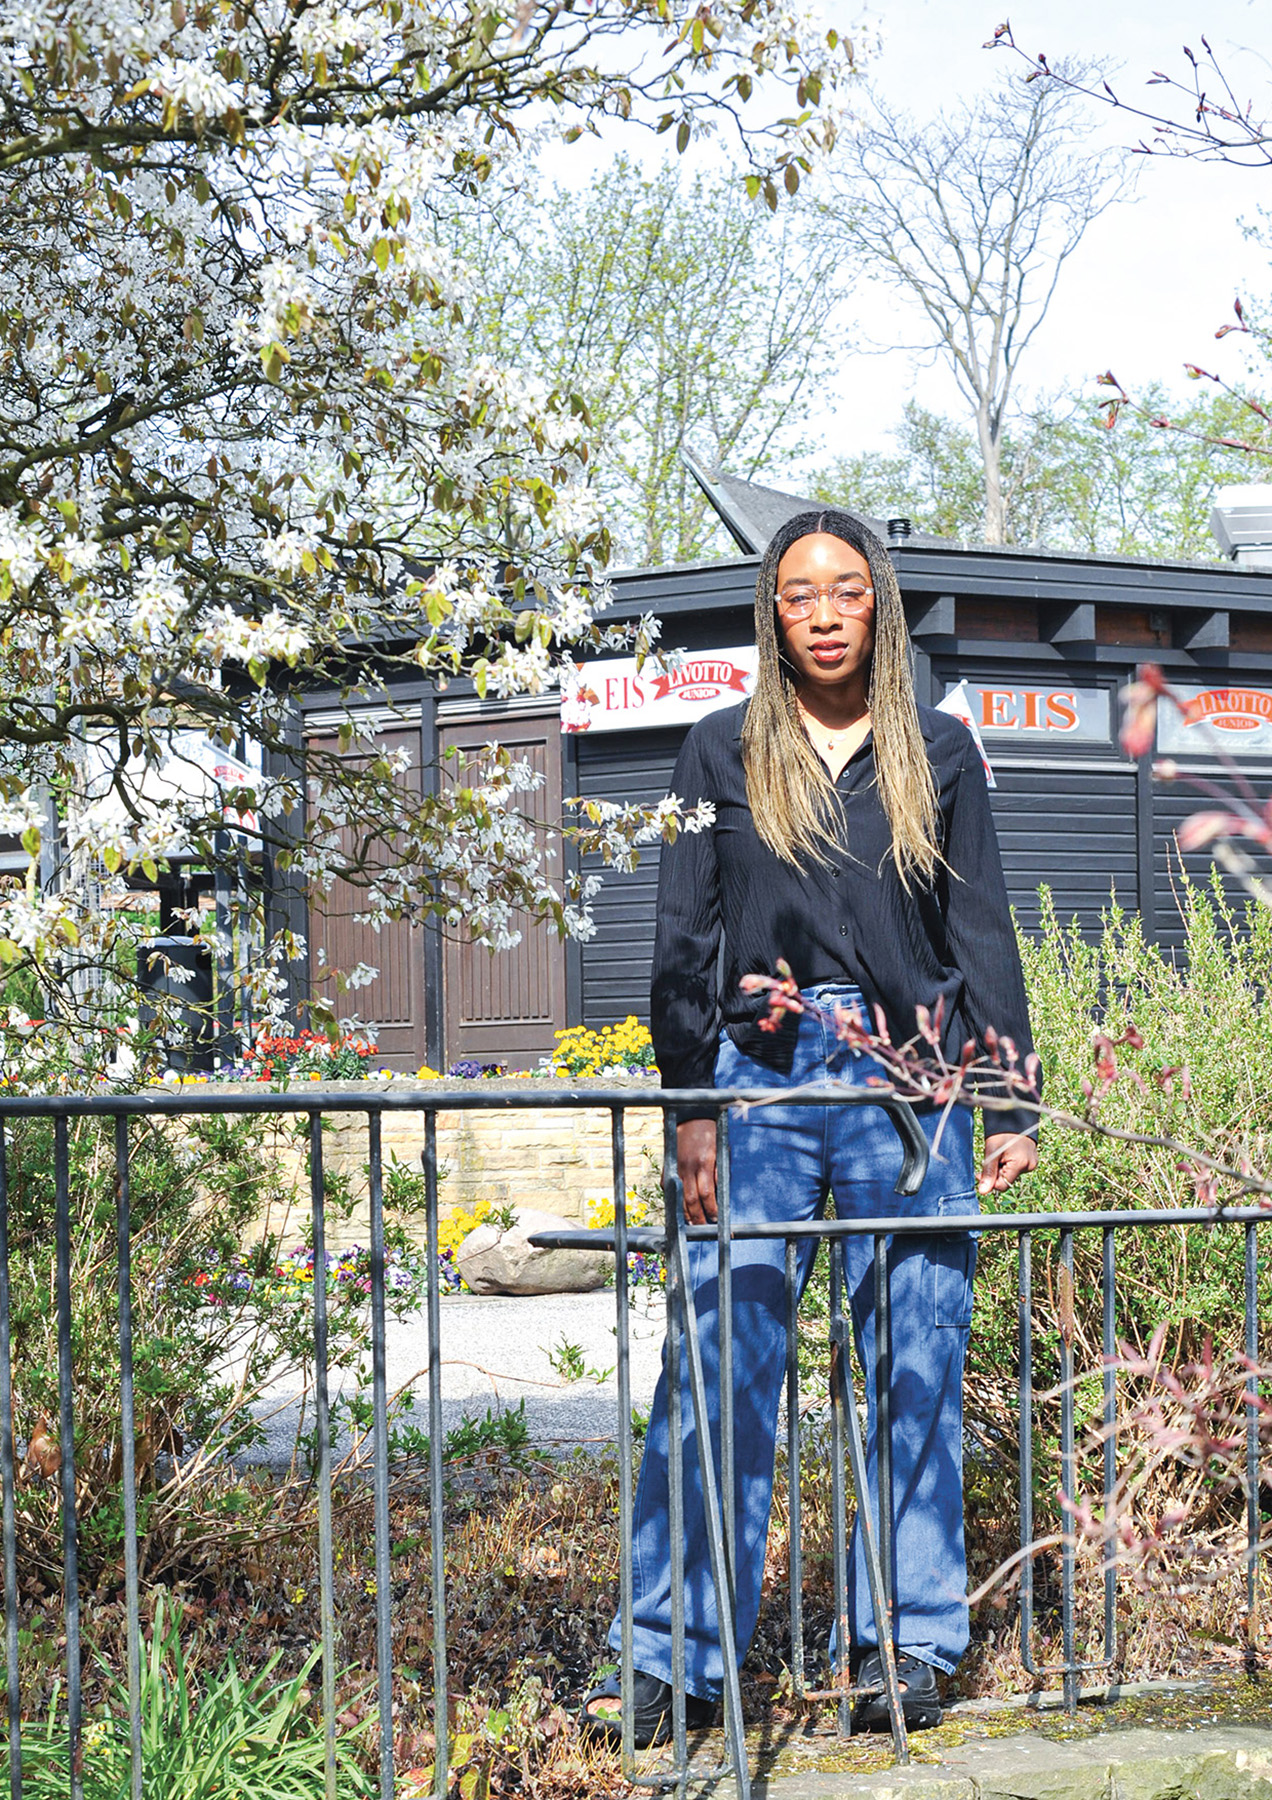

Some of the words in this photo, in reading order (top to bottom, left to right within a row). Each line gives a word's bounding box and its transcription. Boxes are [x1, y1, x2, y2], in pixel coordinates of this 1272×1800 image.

[668, 662, 732, 687] LIVOTTO
[605, 675, 645, 710] EIS
[1199, 692, 1271, 715] LIVOTTO
[976, 689, 1079, 731] EIS
